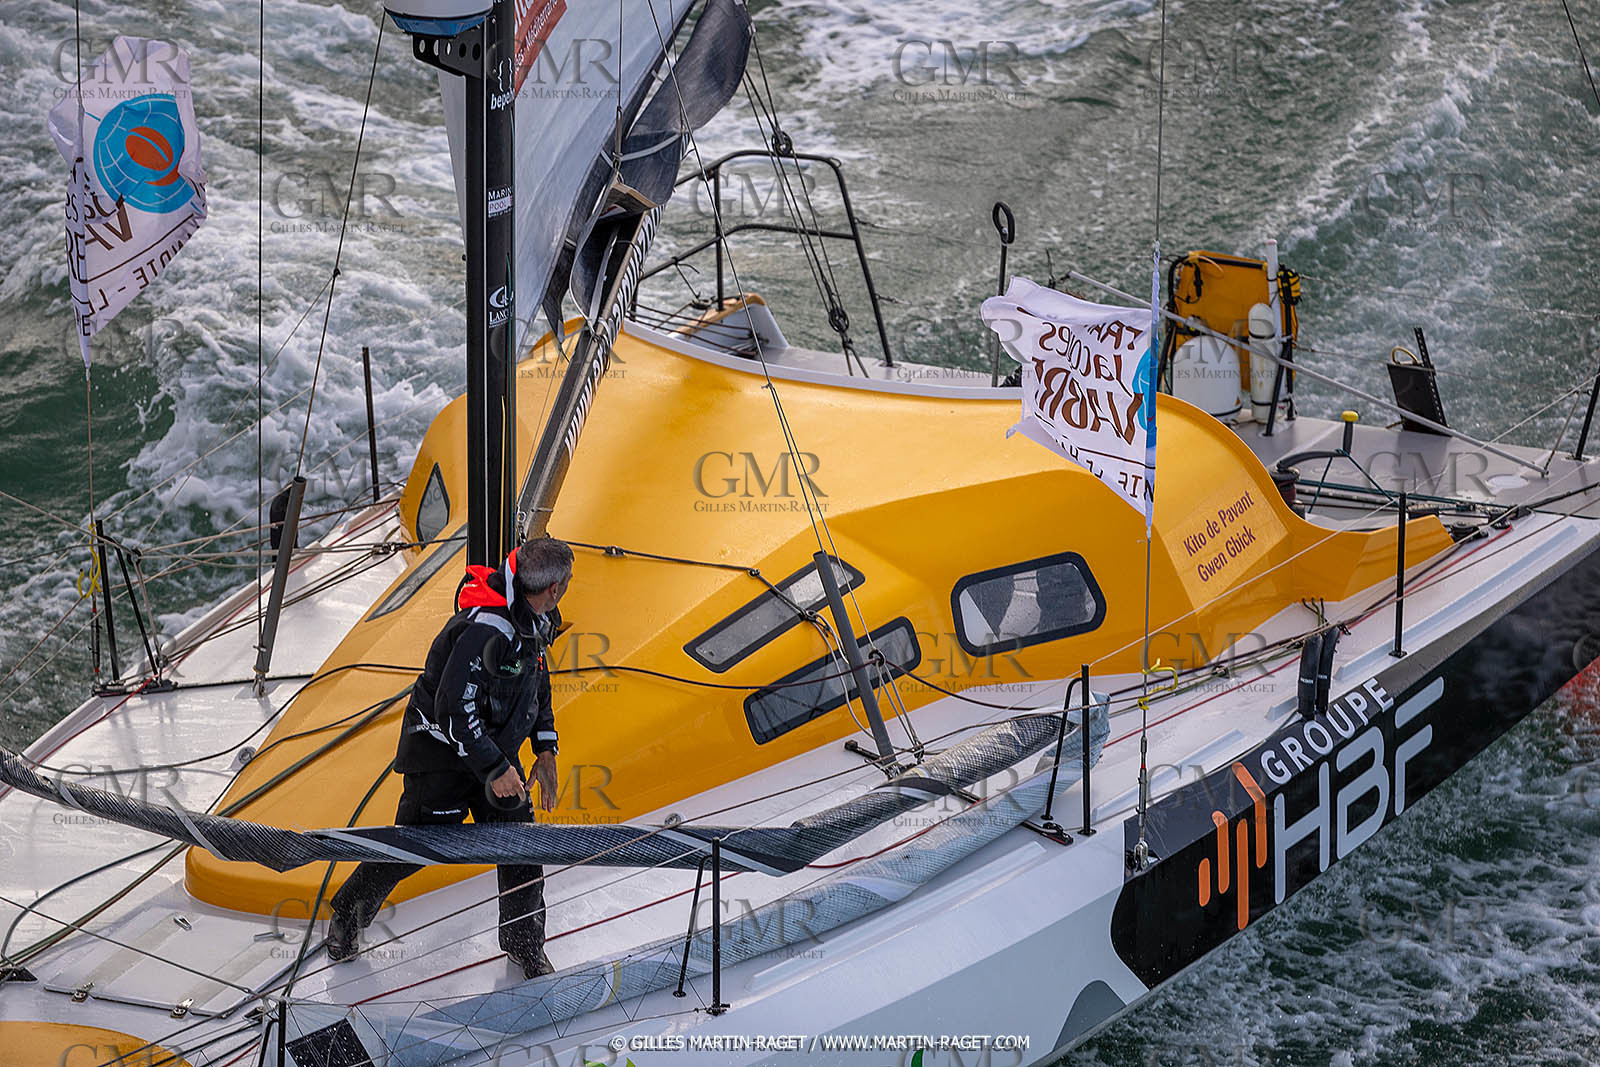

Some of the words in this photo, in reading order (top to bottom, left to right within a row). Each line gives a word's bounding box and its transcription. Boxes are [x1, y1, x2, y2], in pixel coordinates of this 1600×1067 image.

[1183, 532, 1207, 557] Kito
[1205, 519, 1221, 539] de
[1217, 490, 1254, 528] Pavant
[1197, 552, 1228, 582] Gwen
[1225, 525, 1256, 558] Gbick
[1260, 678, 1394, 784] GROUPE
[1273, 676, 1445, 905] HBF
